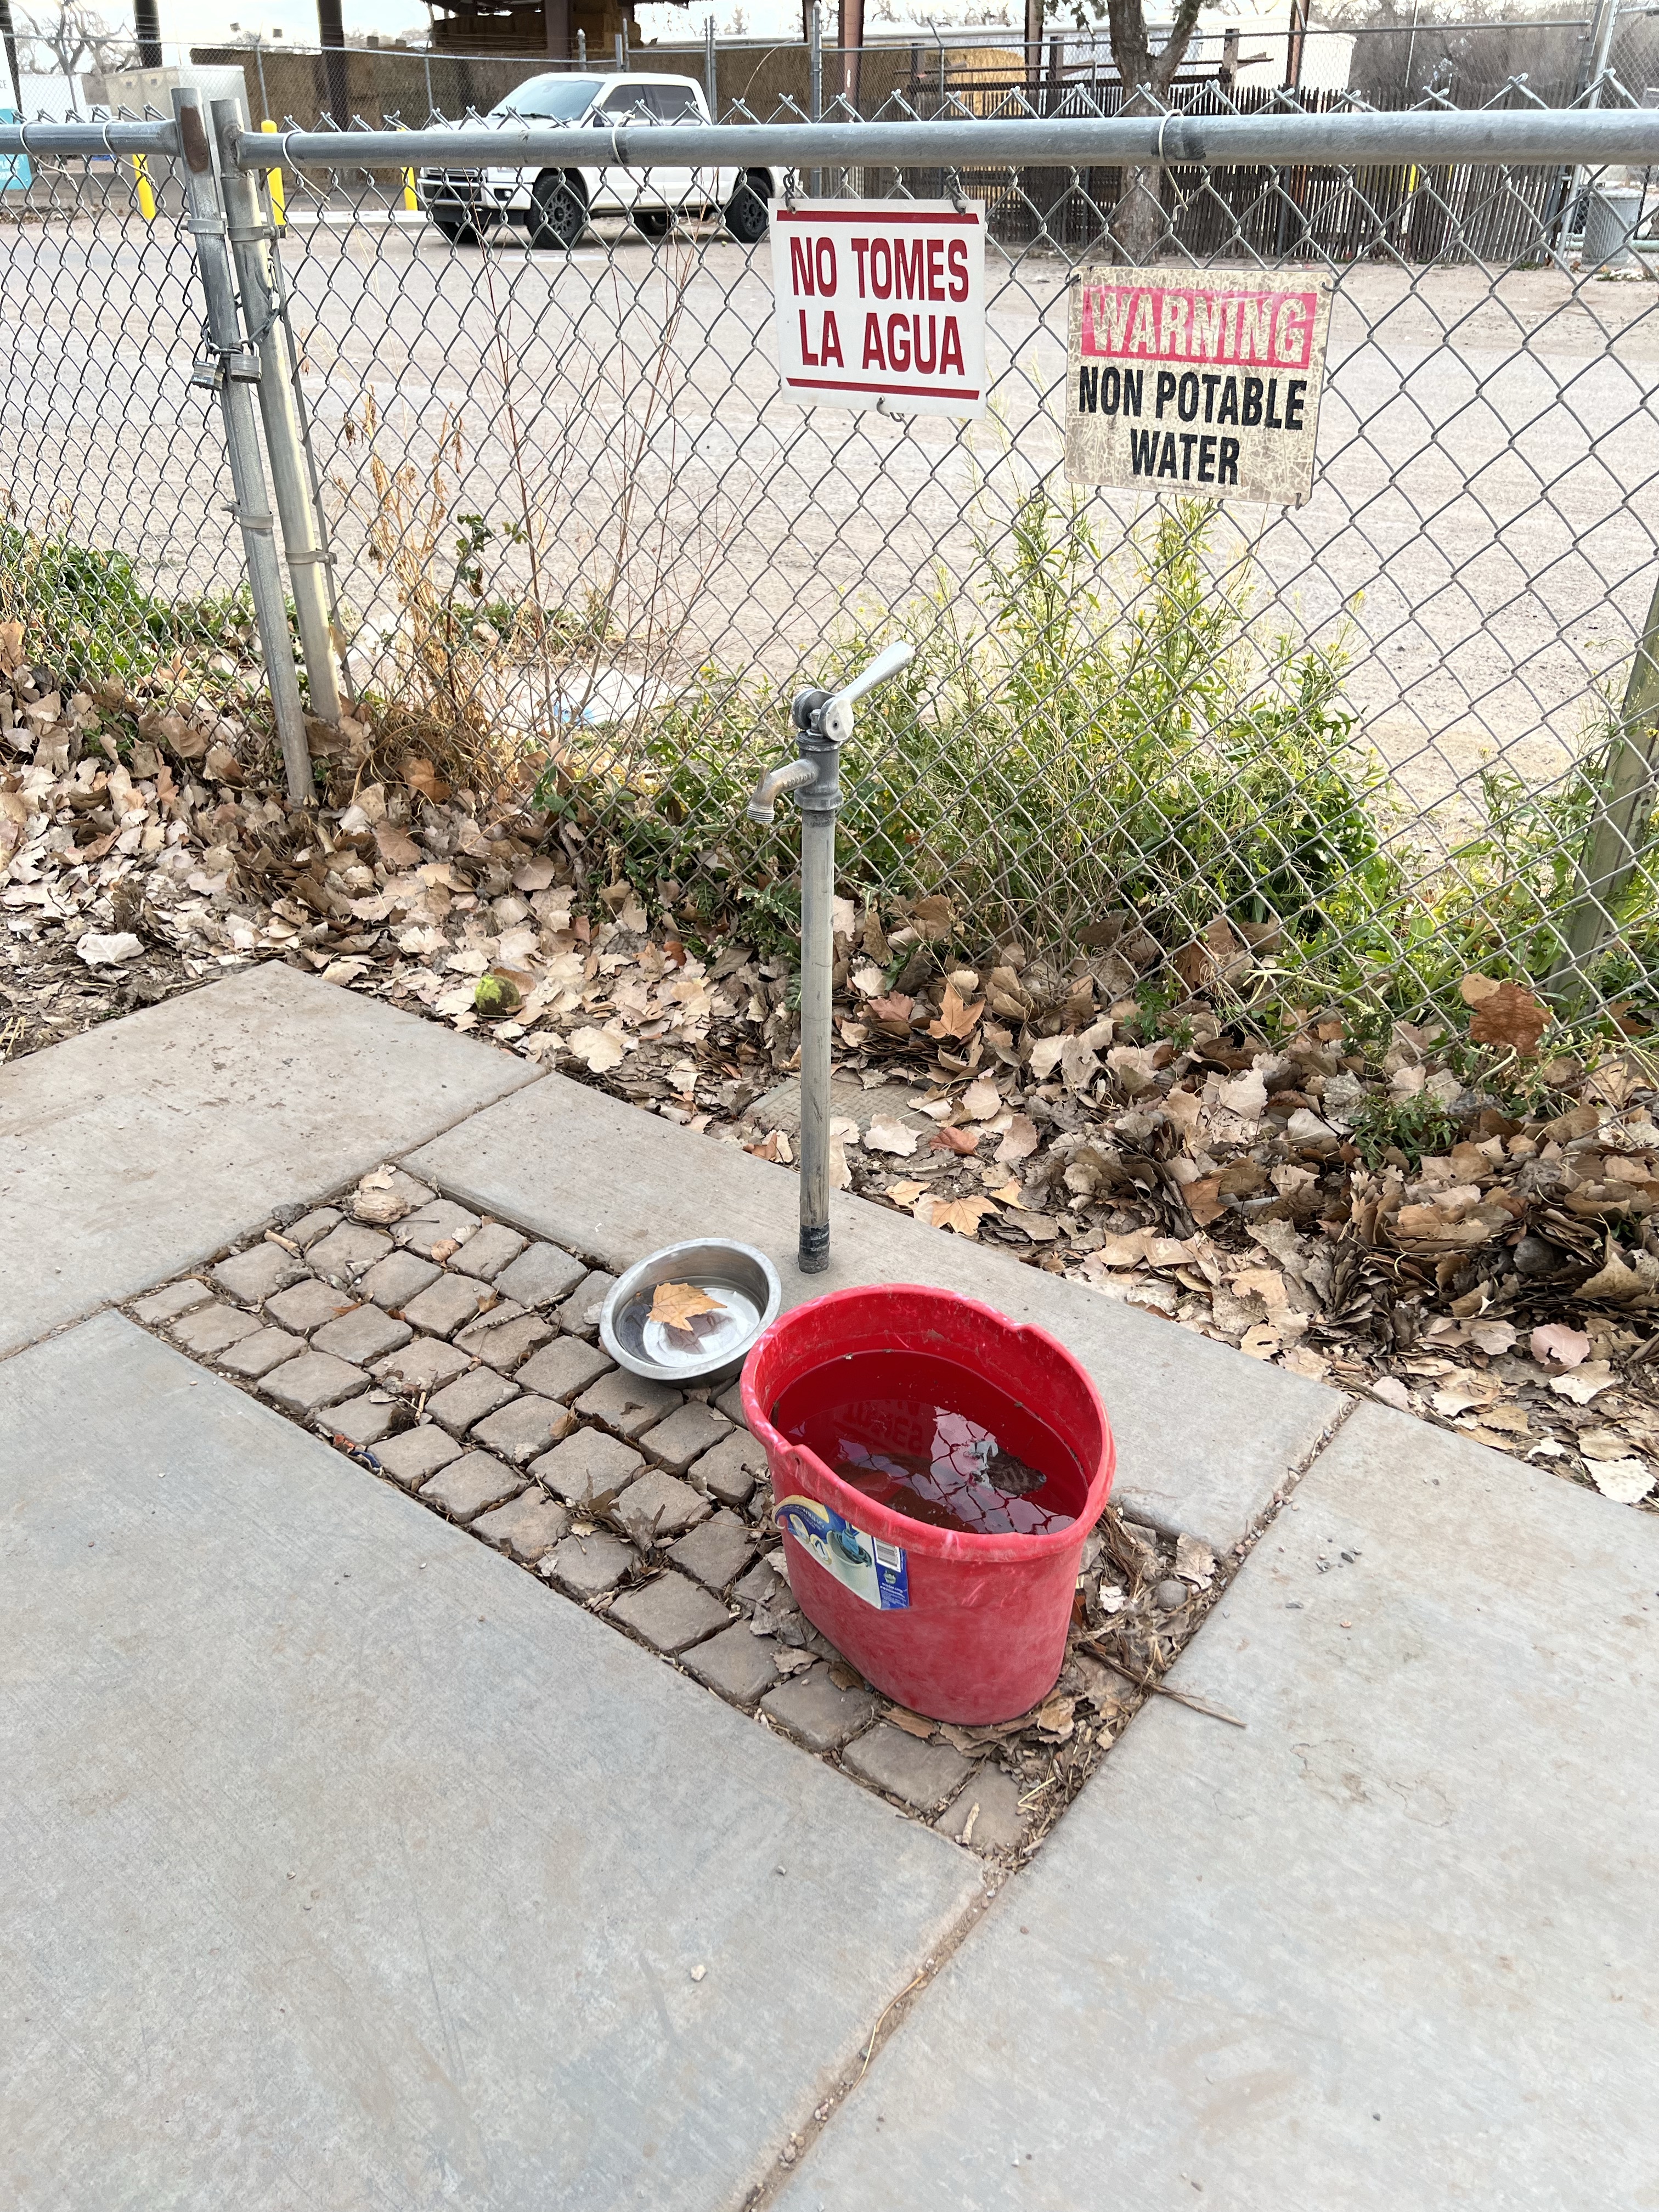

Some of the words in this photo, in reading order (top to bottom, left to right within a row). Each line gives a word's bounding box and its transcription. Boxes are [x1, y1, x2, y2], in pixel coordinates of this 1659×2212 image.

[789, 236, 837, 297] NO
[851, 238, 969, 303] TOMES
[799, 309, 844, 368] LA
[862, 312, 966, 376] AGUA
[1090, 292, 1307, 363] WARNING
[1079, 365, 1144, 417] NON
[1155, 370, 1308, 431] POTABLE
[1130, 428, 1240, 486] WATER
